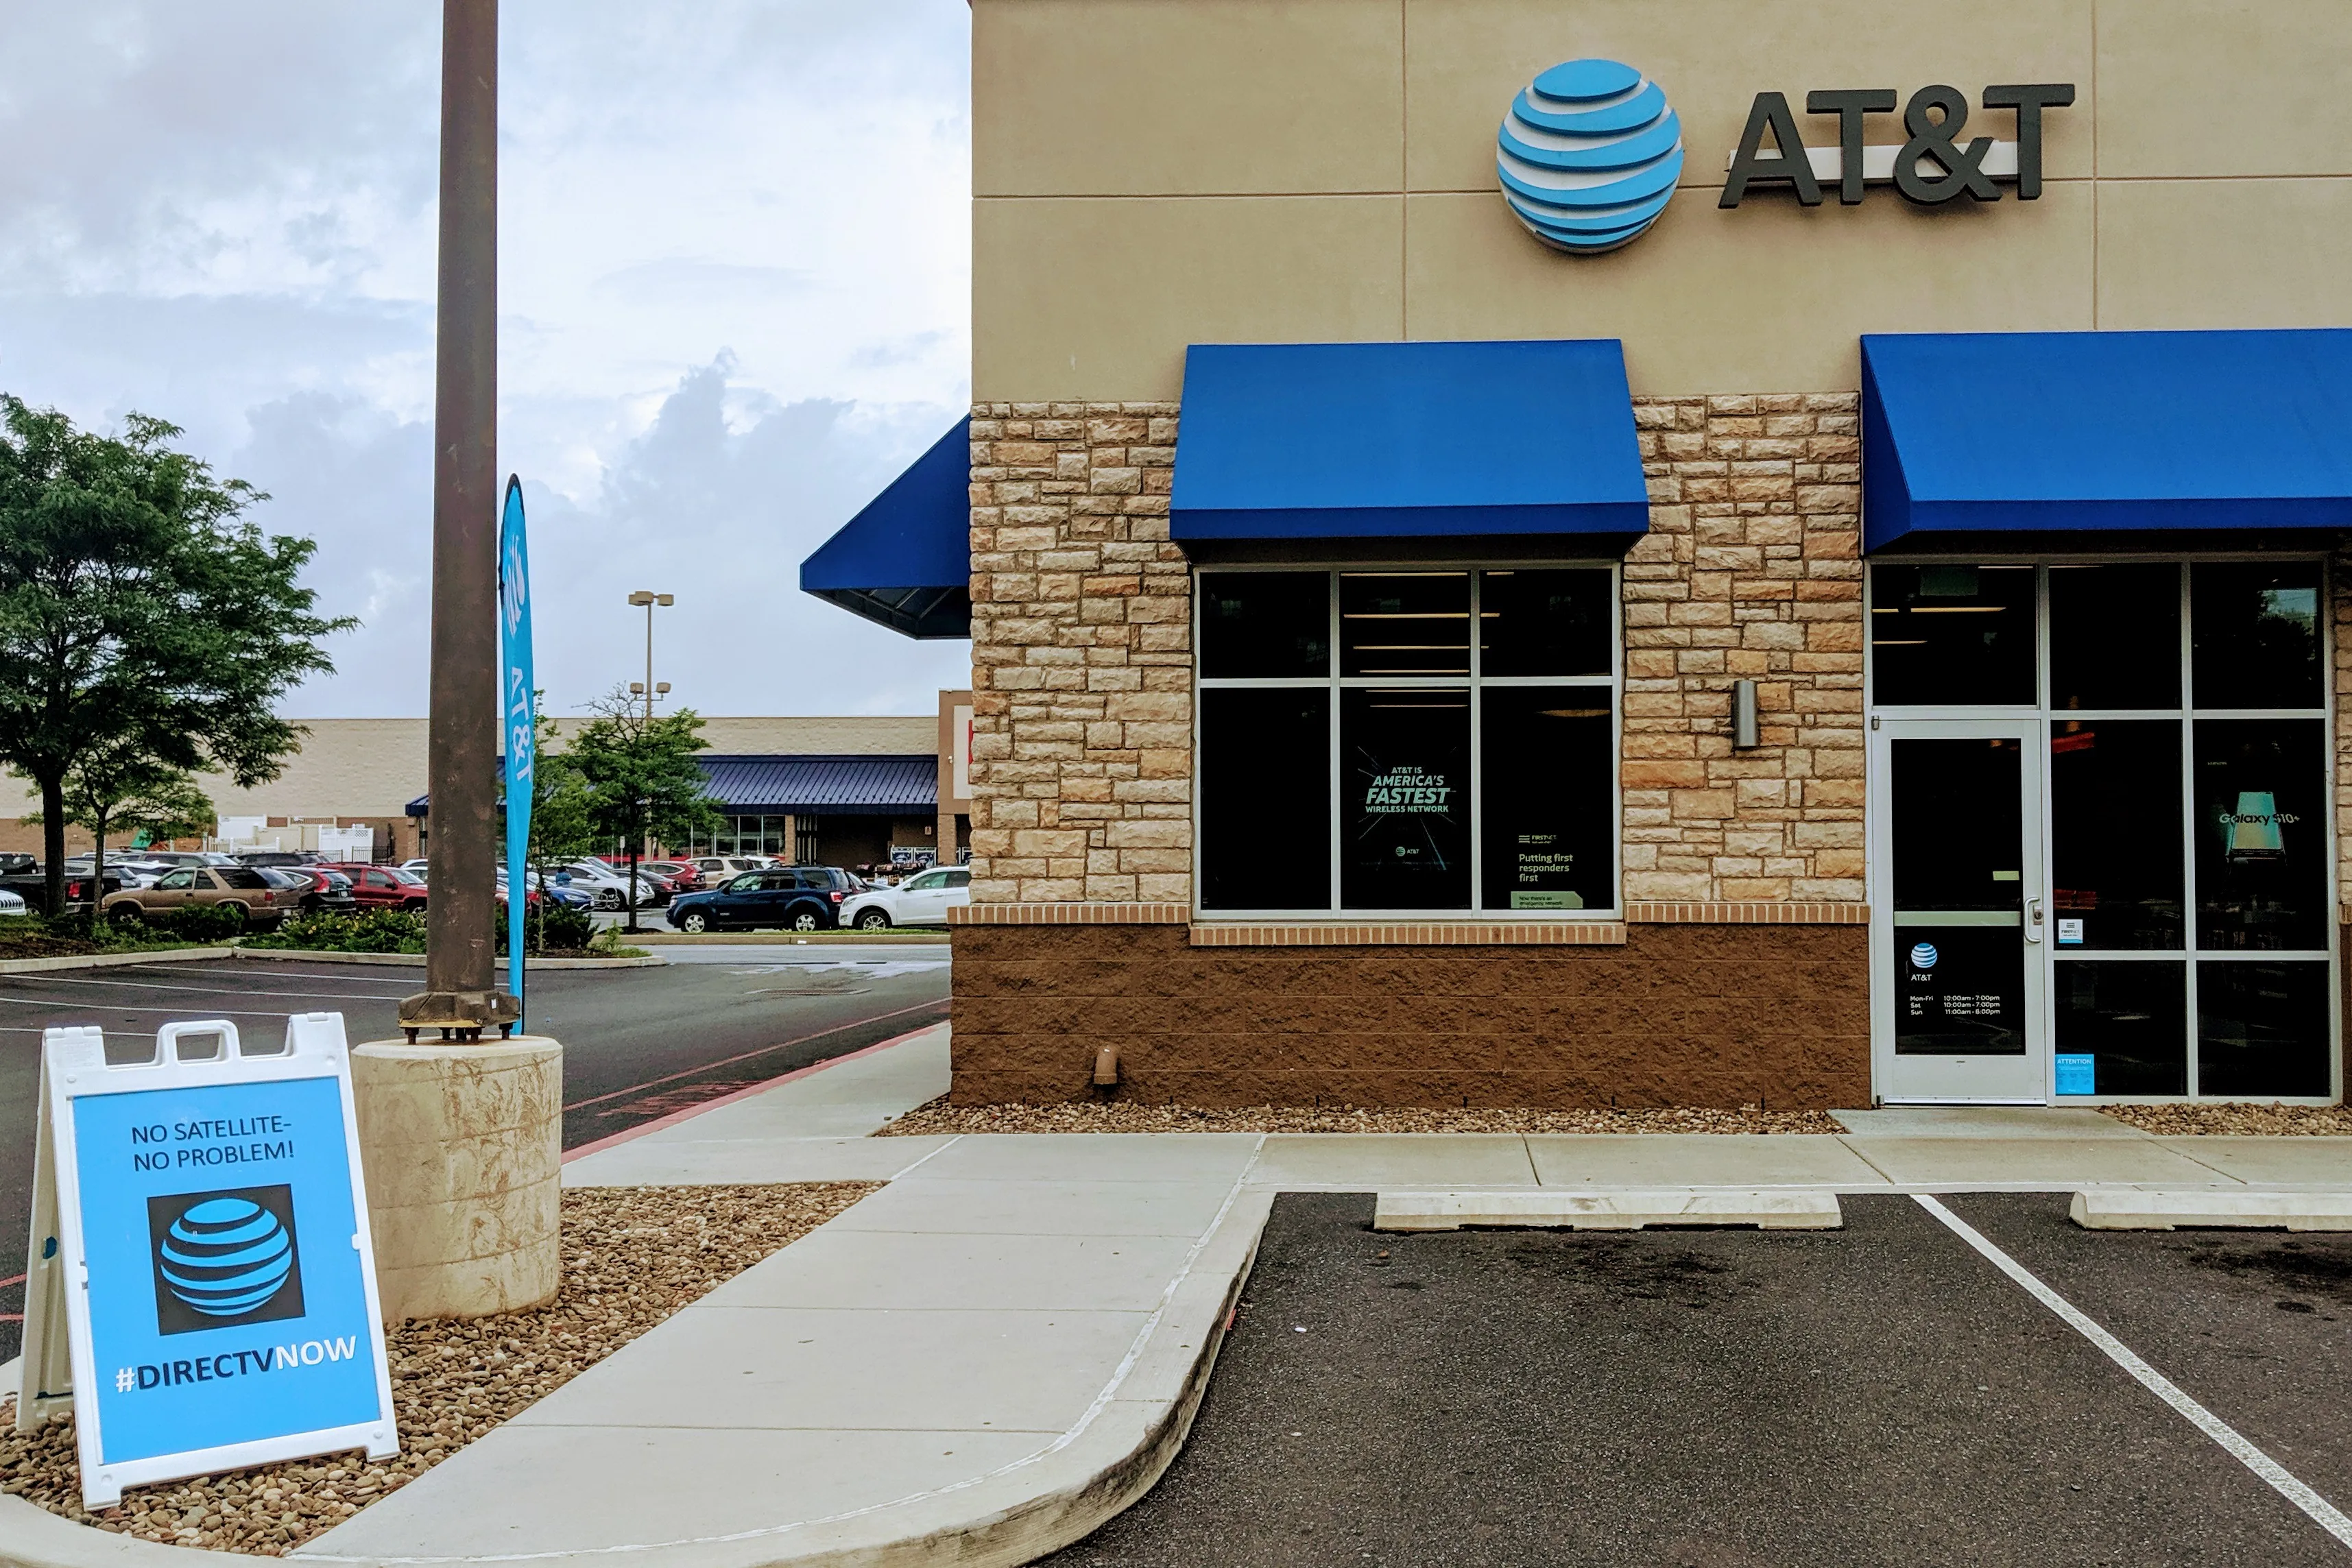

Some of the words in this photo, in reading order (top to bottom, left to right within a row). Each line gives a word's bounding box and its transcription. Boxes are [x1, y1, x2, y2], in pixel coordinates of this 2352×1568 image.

[1717, 83, 2076, 209] AT&T
[511, 666, 531, 782] AT&T
[1371, 775, 1445, 786] AMERICA'S
[1365, 787, 1451, 804] FASTEST
[1365, 805, 1406, 813] WIRELESS
[1407, 805, 1449, 813] NETWORK
[2219, 813, 2270, 825] Galaxy
[2272, 813, 2301, 823] S10+
[1518, 853, 1552, 864] Putting
[1553, 853, 1574, 863] first
[1518, 863, 1570, 874] responders
[1518, 873, 1539, 882] first
[132, 1124, 167, 1144] NO
[134, 1151, 169, 1172] NO
[177, 1139, 295, 1168] PROBLEM!
[115, 1335, 357, 1393] #DIRECTVNOW
